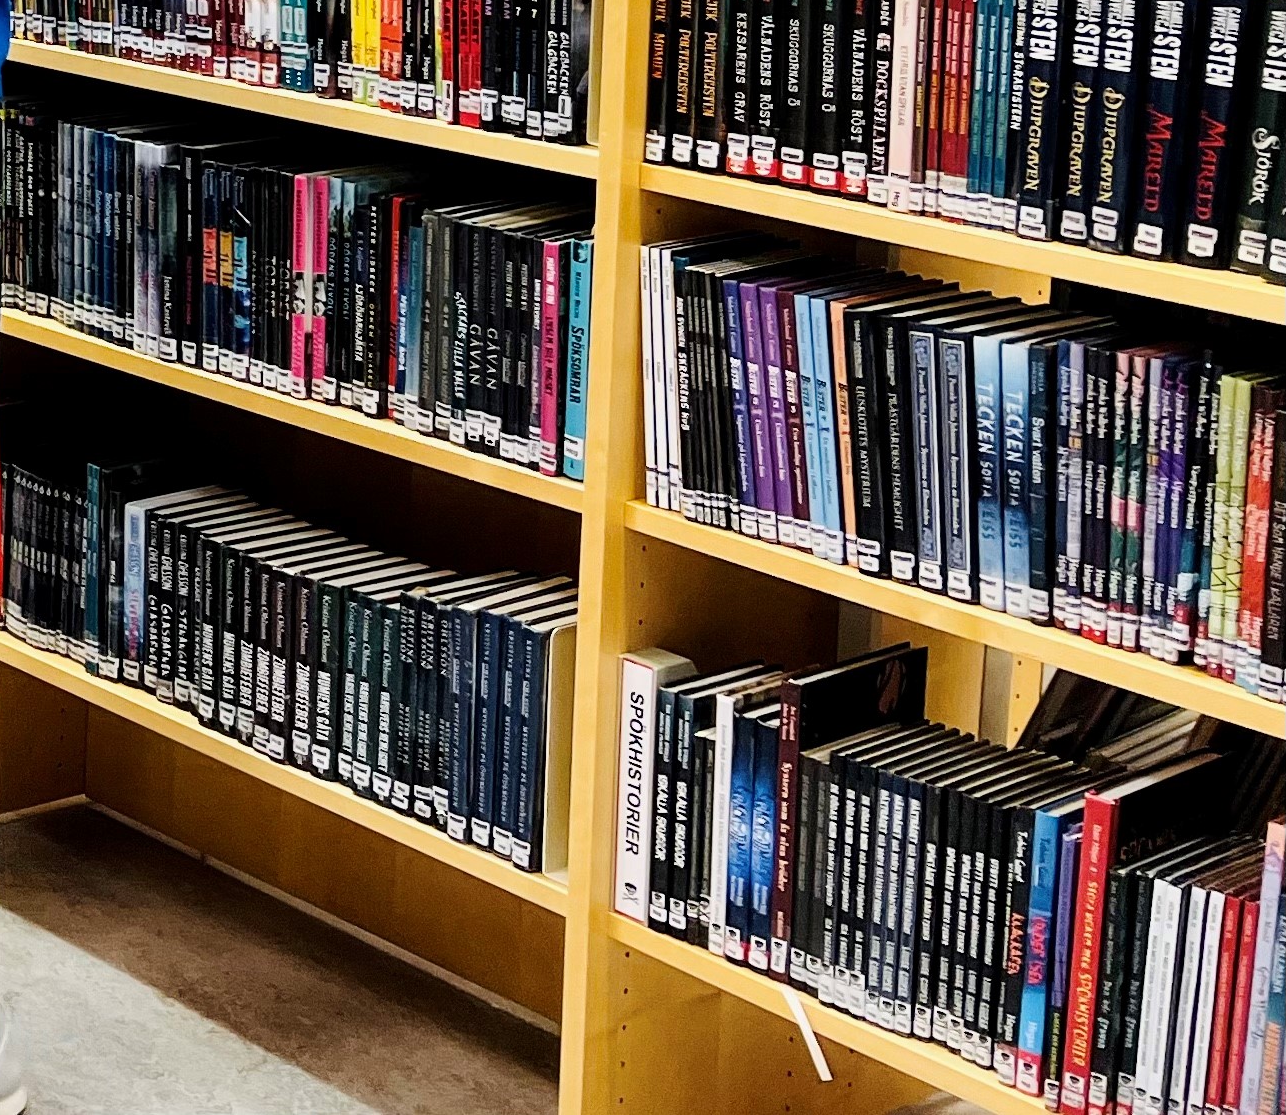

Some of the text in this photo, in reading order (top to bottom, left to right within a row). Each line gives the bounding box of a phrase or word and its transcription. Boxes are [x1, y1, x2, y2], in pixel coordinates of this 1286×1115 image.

[405, 54, 414, 78] Hegas
[422, 56, 431, 80] Hegas
[546, 31, 558, 94] GALGBACKEN
[559, 32, 570, 96] GALGBACKEN
[676, 29, 692, 114] POLTERGEISTEN
[702, 32, 717, 117] POLTERGEISTEN
[733, 13, 747, 123] KEJSARENS GRAV
[758, 15, 773, 126] VÅLNADENS RÖST
[787, 18, 800, 106] SKUGGORNAS Ö
[822, 23, 835, 98] SKUGGORNAS
[850, 28, 865, 143] VÅLNADENS RÖST
[1024, 17, 1058, 191] STEN DJUPGRAVEN
[822, 103, 836, 112] Ö
[872, 60, 891, 174] DOCKSPELAREN
[1097, 27, 1134, 203] STEN DJUPGRAVEN
[1144, 35, 1182, 212] STEN MARELD
[1196, 41, 1237, 220] STEN MARELD
[1249, 128, 1281, 205] SJÖRÖK
[677, 352, 689, 409] SKRÄCKENS
[977, 383, 997, 498] TECKEN SOFIA
[1005, 390, 1024, 507] TECKEN SOFIA
[1031, 416, 1045, 484] Svart vatten
[624, 691, 648, 855] SPÖKHISTORIER
[779, 761, 793, 798] Systern
[1072, 972, 1093, 1066] SPÖKHISTORIER
